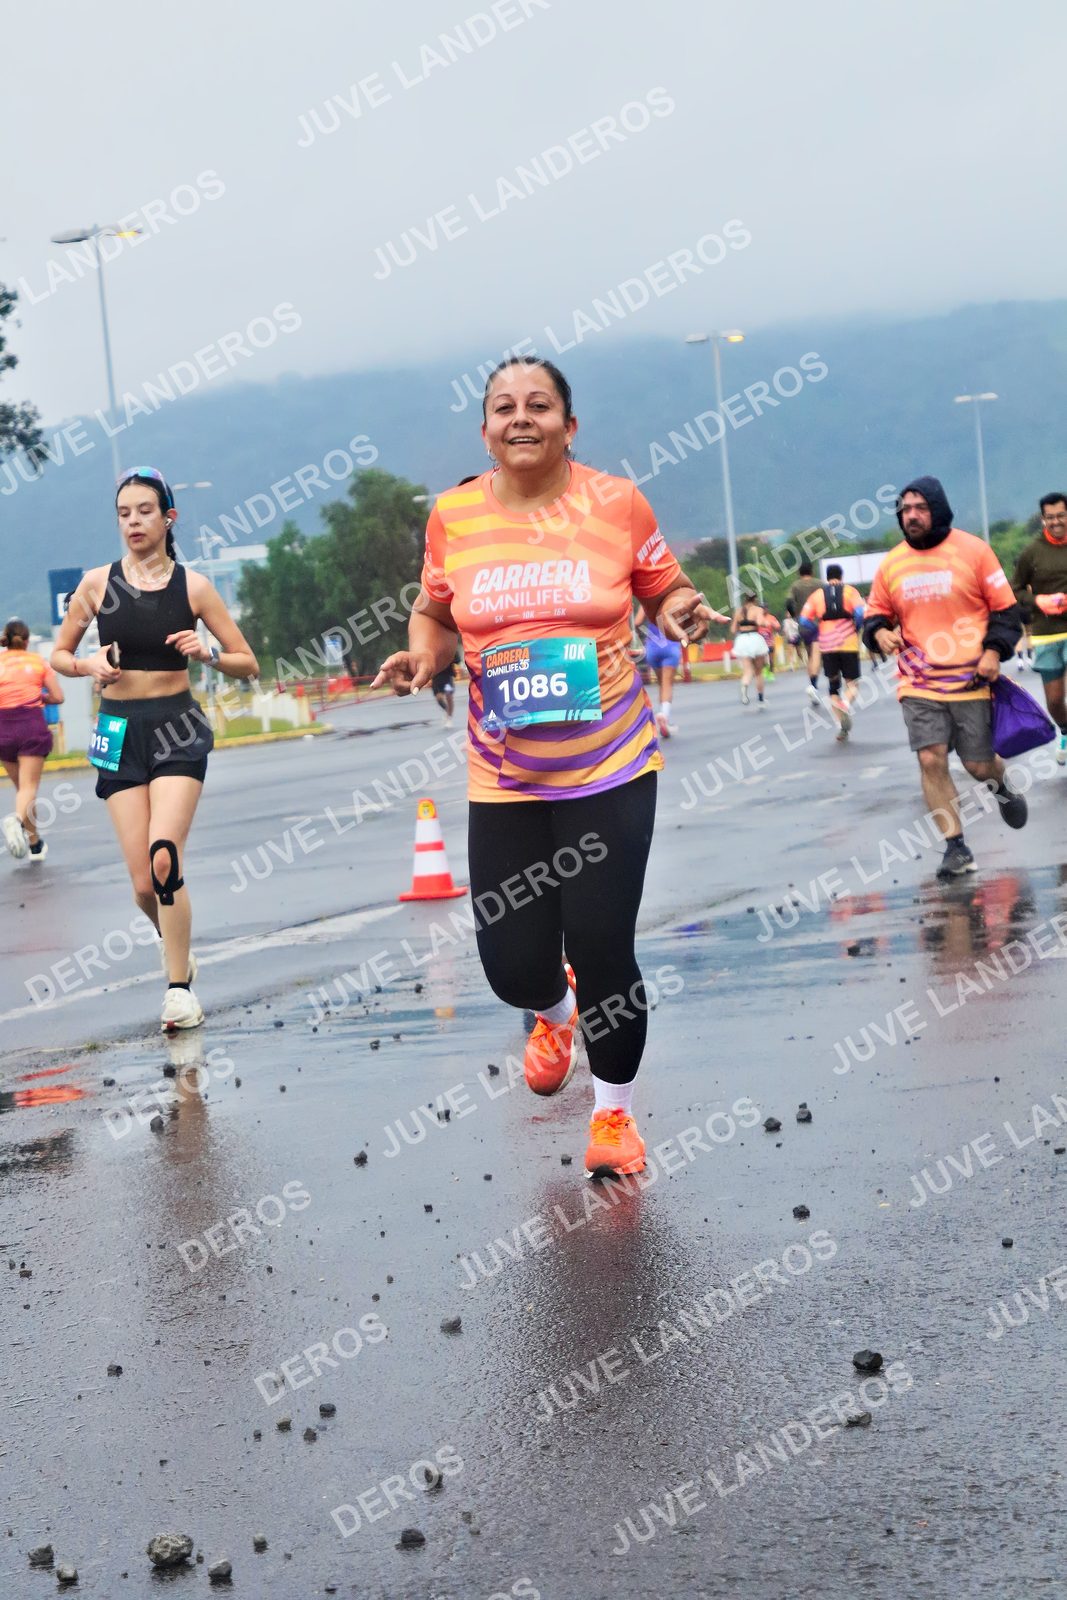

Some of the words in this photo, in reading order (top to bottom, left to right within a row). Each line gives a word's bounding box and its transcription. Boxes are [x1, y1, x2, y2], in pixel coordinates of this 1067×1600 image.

[472, 560, 590, 595] CARRERA
[486, 647, 530, 669] CARRERA
[563, 643, 587, 661] 10K
[498, 672, 569, 703] 1086
